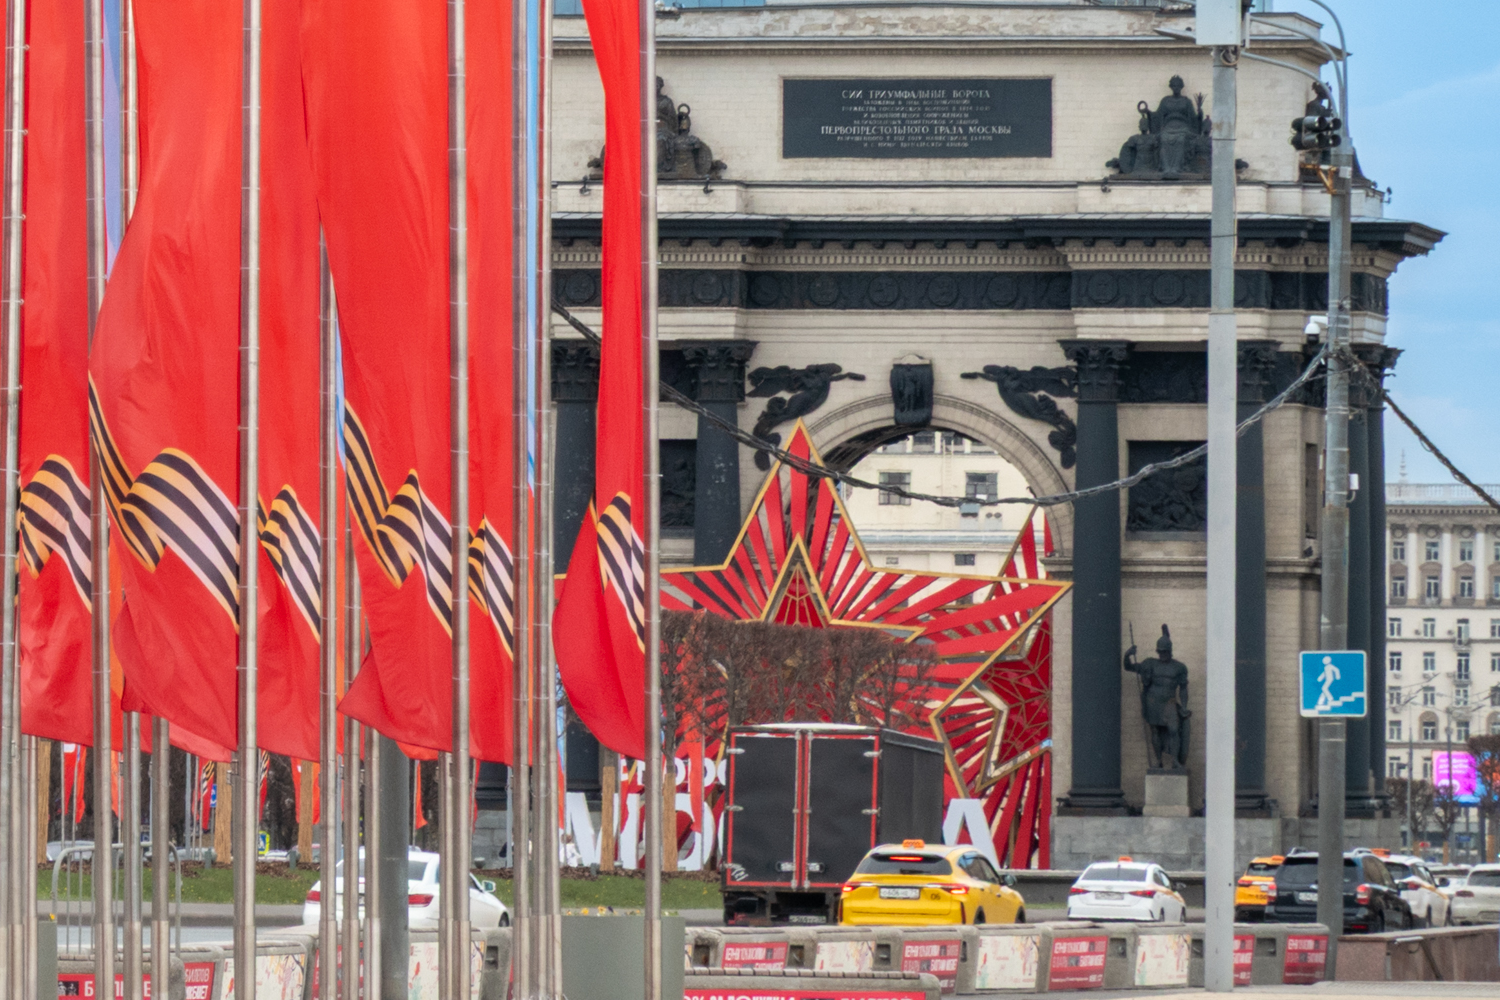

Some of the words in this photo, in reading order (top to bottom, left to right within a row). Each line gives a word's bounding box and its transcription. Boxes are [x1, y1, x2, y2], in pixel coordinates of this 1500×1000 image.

[841, 89, 863, 99] СИИ
[869, 89, 947, 99] ТРИУМФАЛЬНЫЕ
[952, 89, 991, 99] ВОРОТА
[821, 125, 930, 135] ПЕРВОПРЕСТОЛЬНОГО
[934, 125, 963, 136] ГРАДА
[968, 125, 1012, 135] МОСКВЫ
